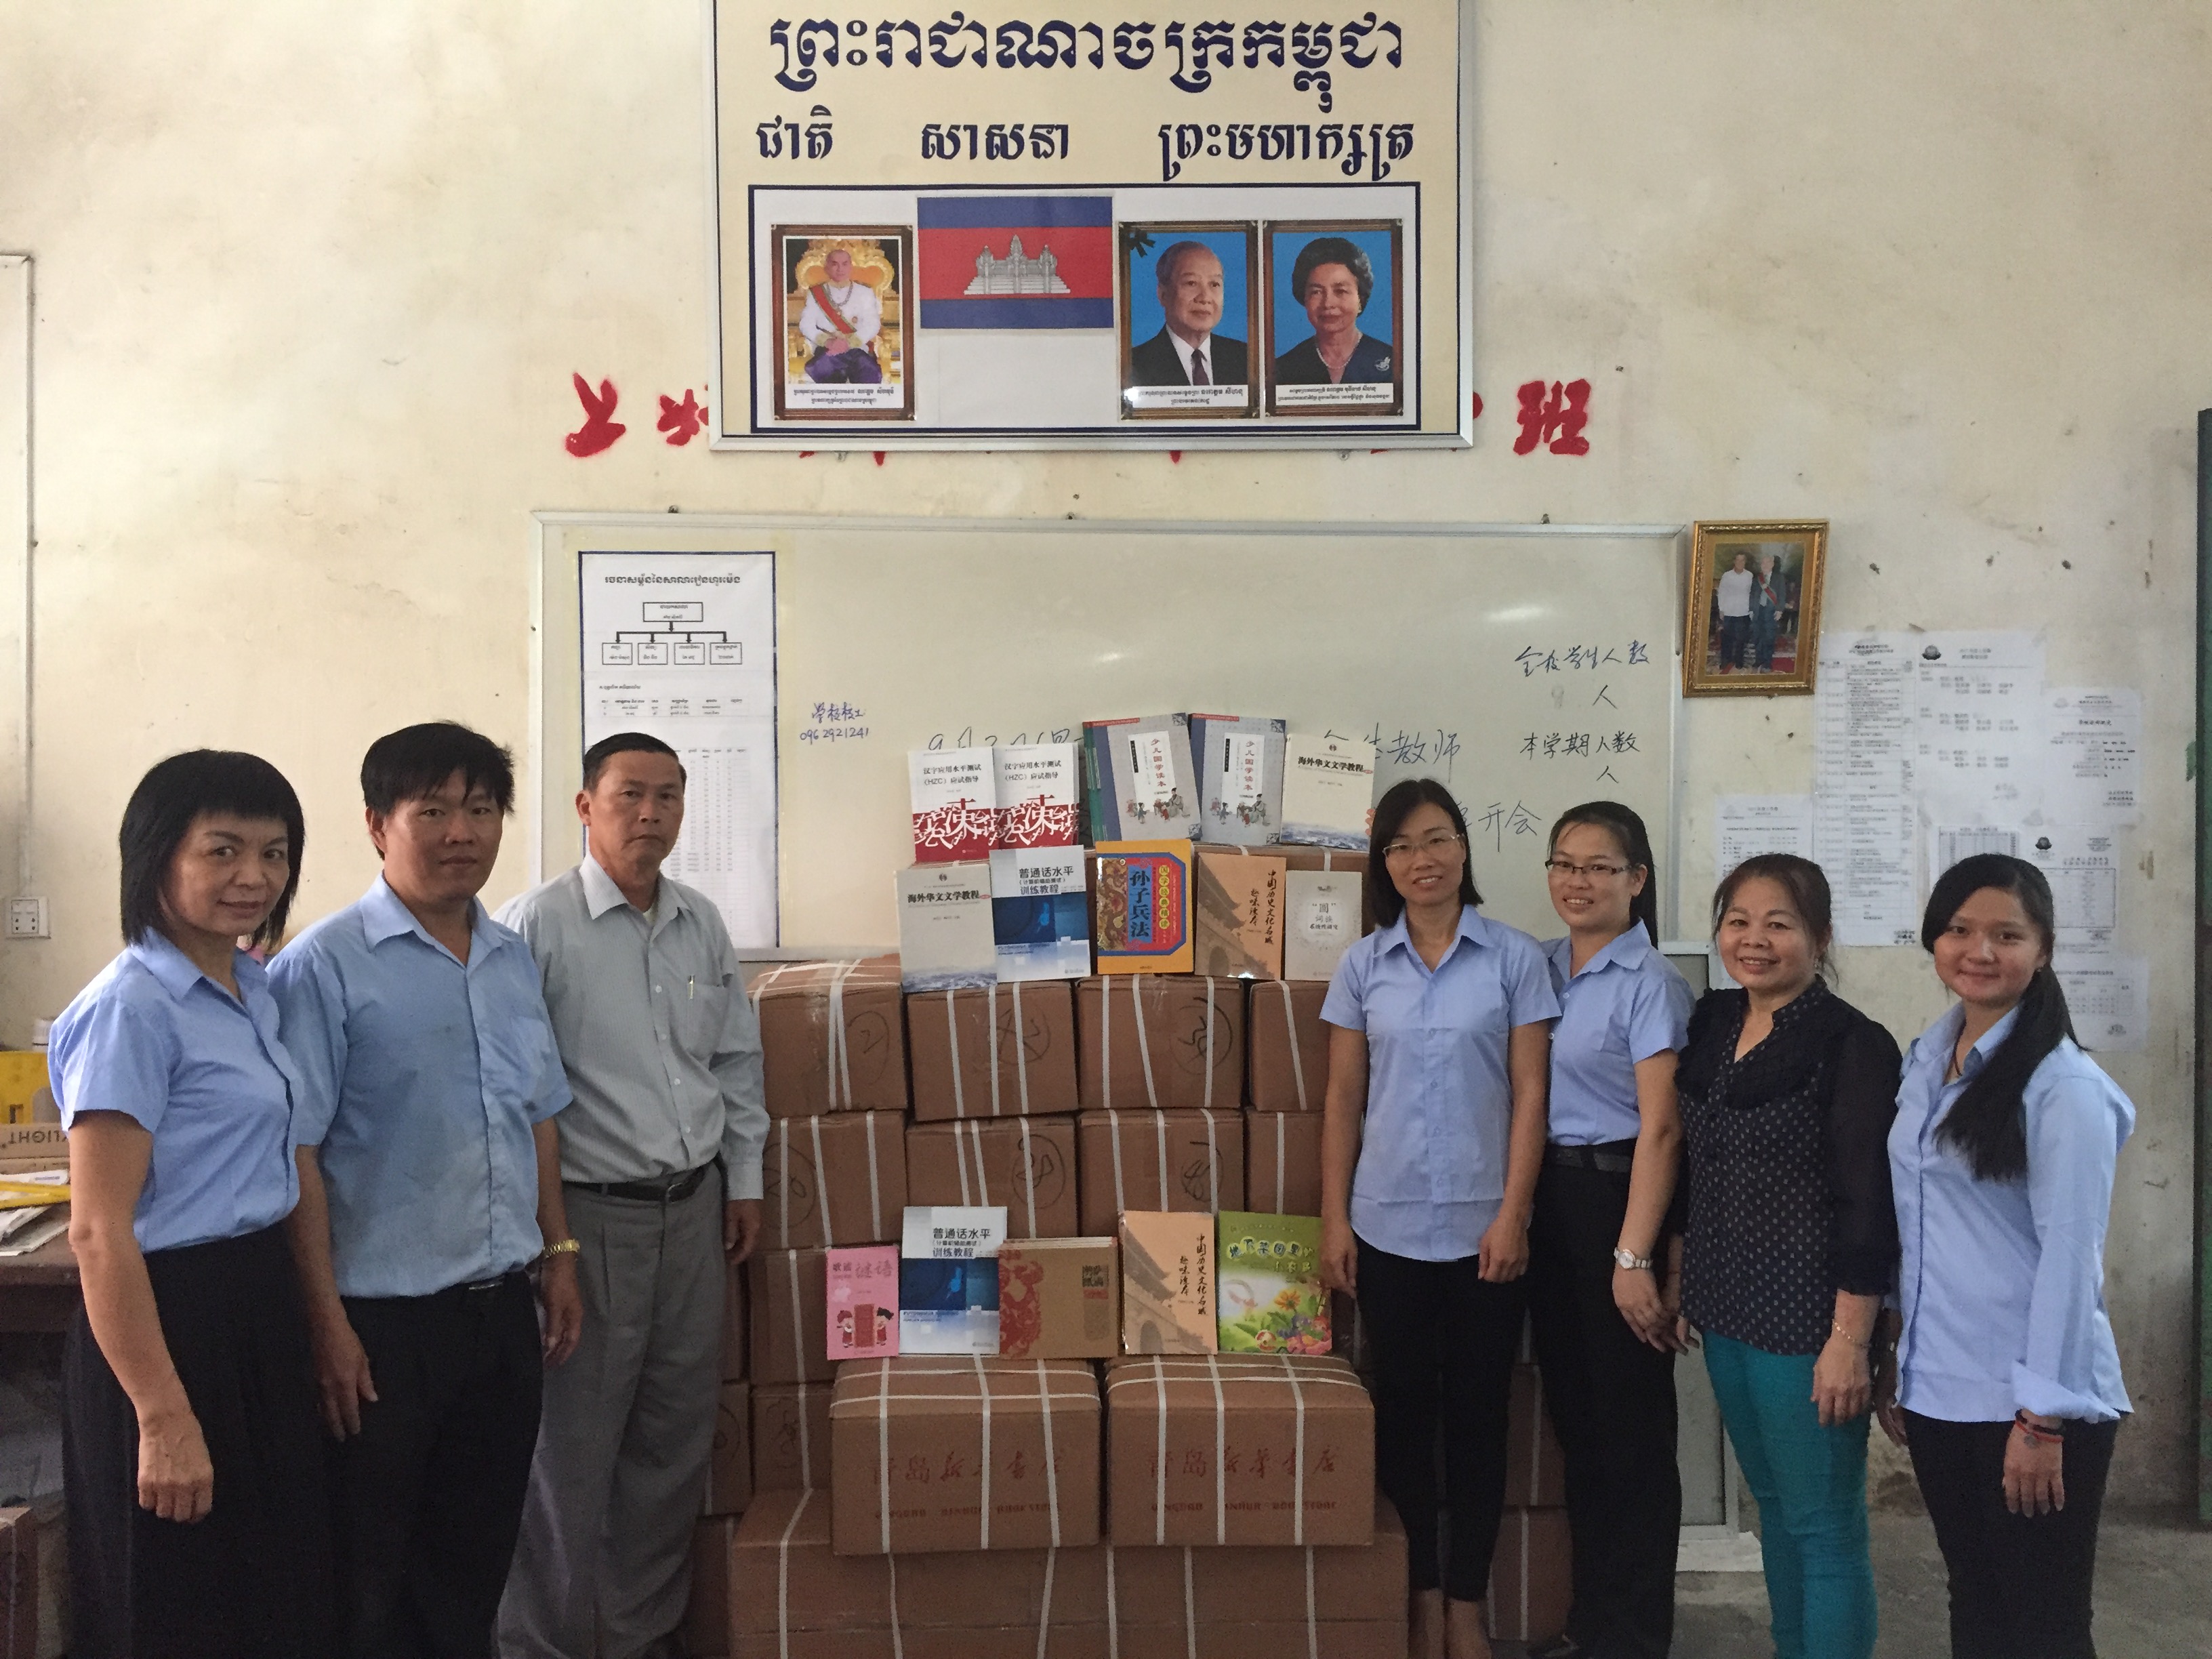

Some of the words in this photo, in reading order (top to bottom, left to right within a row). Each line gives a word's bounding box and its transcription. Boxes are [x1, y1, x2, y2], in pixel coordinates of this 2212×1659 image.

[770, 12, 1404, 114] ព្រះរាជាណាចក្រកម្ពុជា
[755, 104, 833, 161] ជាតិ
[921, 123, 1069, 161] សាសនា
[1158, 123, 1414, 182] ព្រះមហាក្សត្រ
[1593, 684, 1618, 710] 人
[1520, 731, 1641, 760] 本学期人数
[924, 764, 982, 775] 汉字应用水平测试
[1004, 760, 1062, 771] 汉字应用水平测试
[1298, 756, 1364, 772] 海外华文文学教程
[1596, 766, 1620, 783] 人
[1019, 865, 1074, 879] 普通话水平
[907, 890, 979, 903] 海外华文文学教程
[1021, 884, 1059, 895] 训练教程
[1129, 870, 1150, 937] 孙子兵法
[933, 1227, 991, 1239] 普通话水平
[933, 1247, 974, 1257] 训练教程
